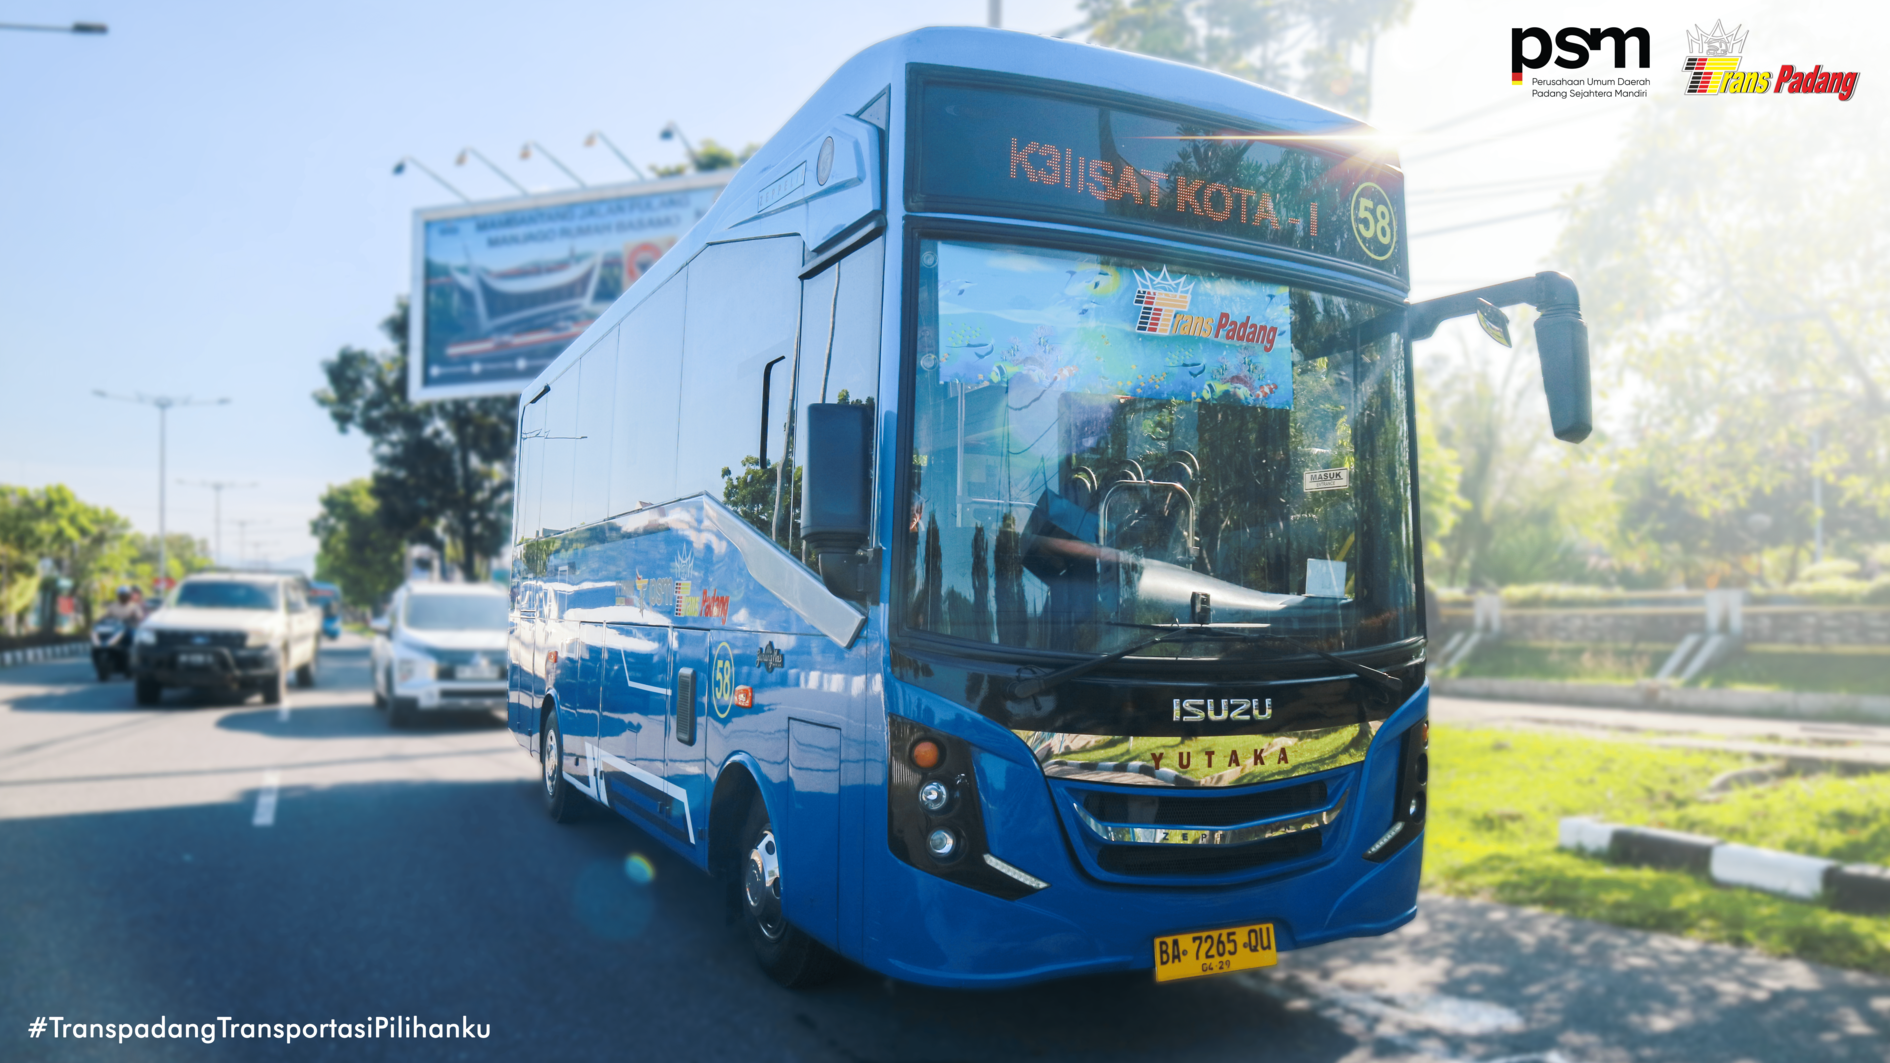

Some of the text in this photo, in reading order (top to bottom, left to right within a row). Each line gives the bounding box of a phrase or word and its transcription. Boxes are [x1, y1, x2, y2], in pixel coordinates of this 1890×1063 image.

[1176, 176, 1280, 230] KOTA
[1357, 197, 1392, 247] 58
[1133, 287, 1278, 353] Trans Padang
[1310, 471, 1342, 481] MASUK
[674, 580, 730, 626] Trans Padang
[715, 659, 731, 701] 58
[1172, 698, 1273, 722] ISUZU
[1150, 747, 1290, 771] YUTAKA
[1159, 926, 1272, 966] BA 7265 QU
